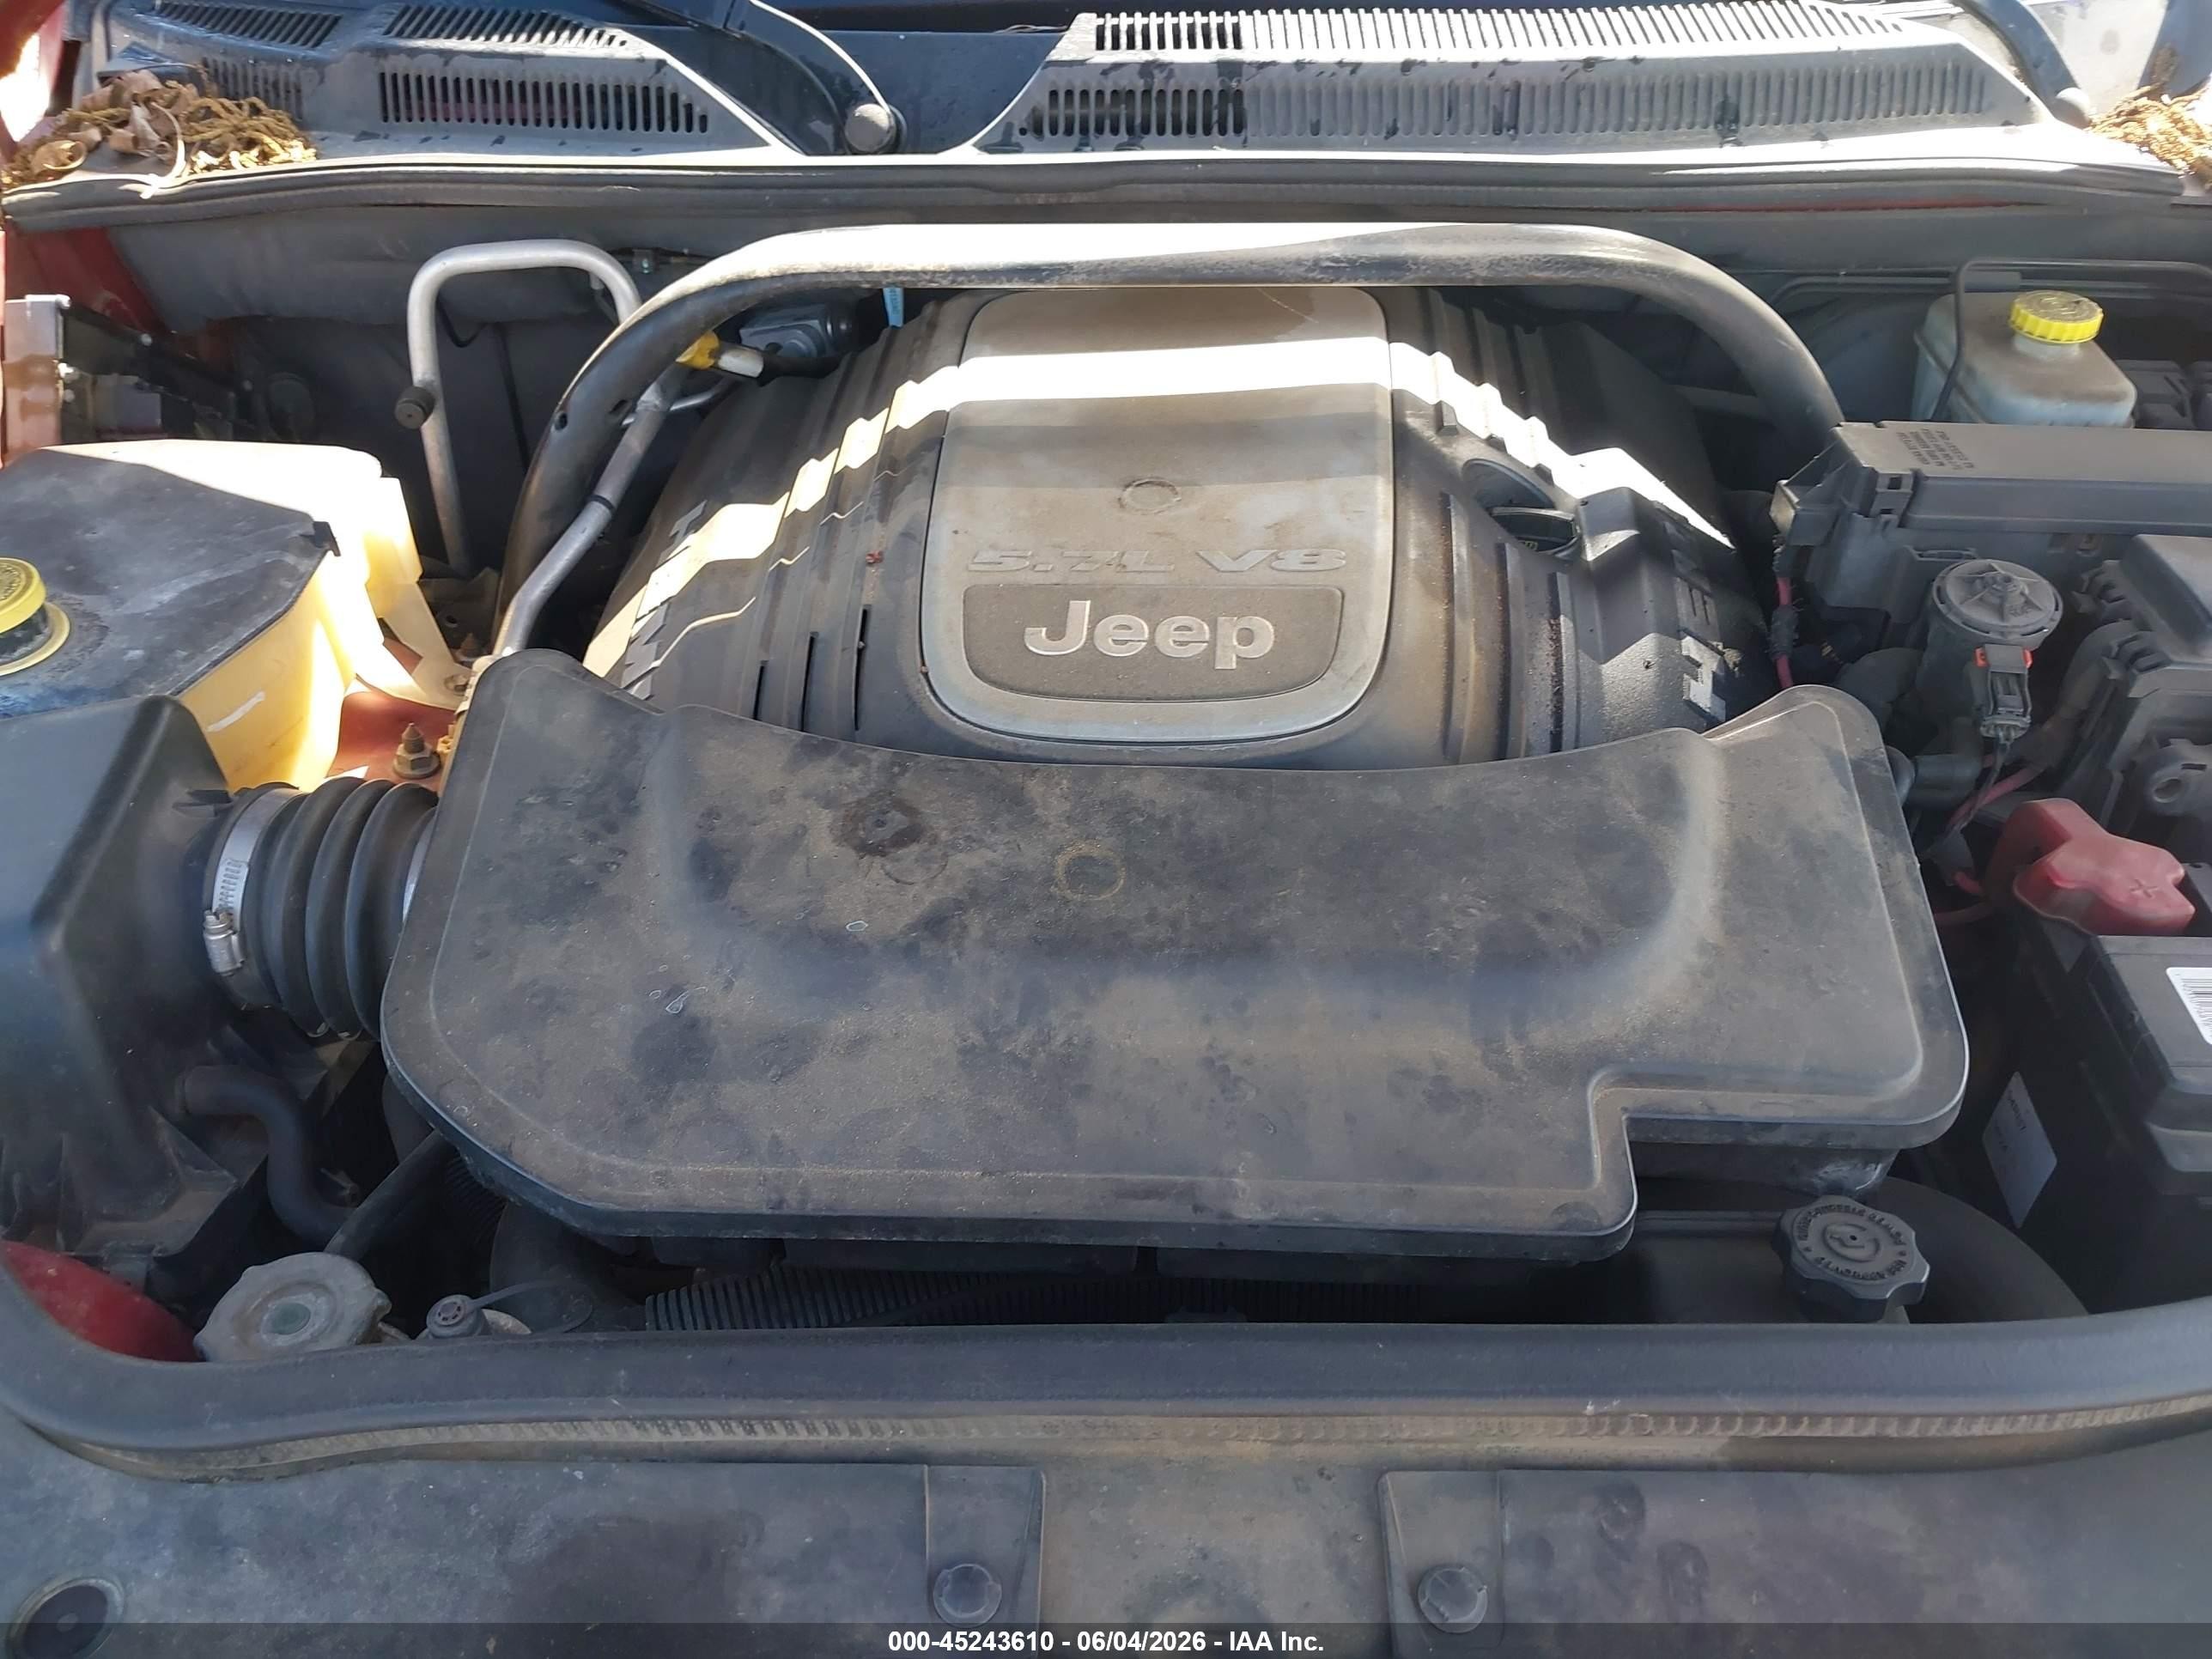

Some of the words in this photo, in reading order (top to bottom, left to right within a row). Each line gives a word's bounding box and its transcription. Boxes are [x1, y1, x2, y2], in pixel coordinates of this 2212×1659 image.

[967, 549, 1176, 574] 5.7L
[1195, 548, 1347, 574] V8
[1023, 599, 1276, 671] Jeep
